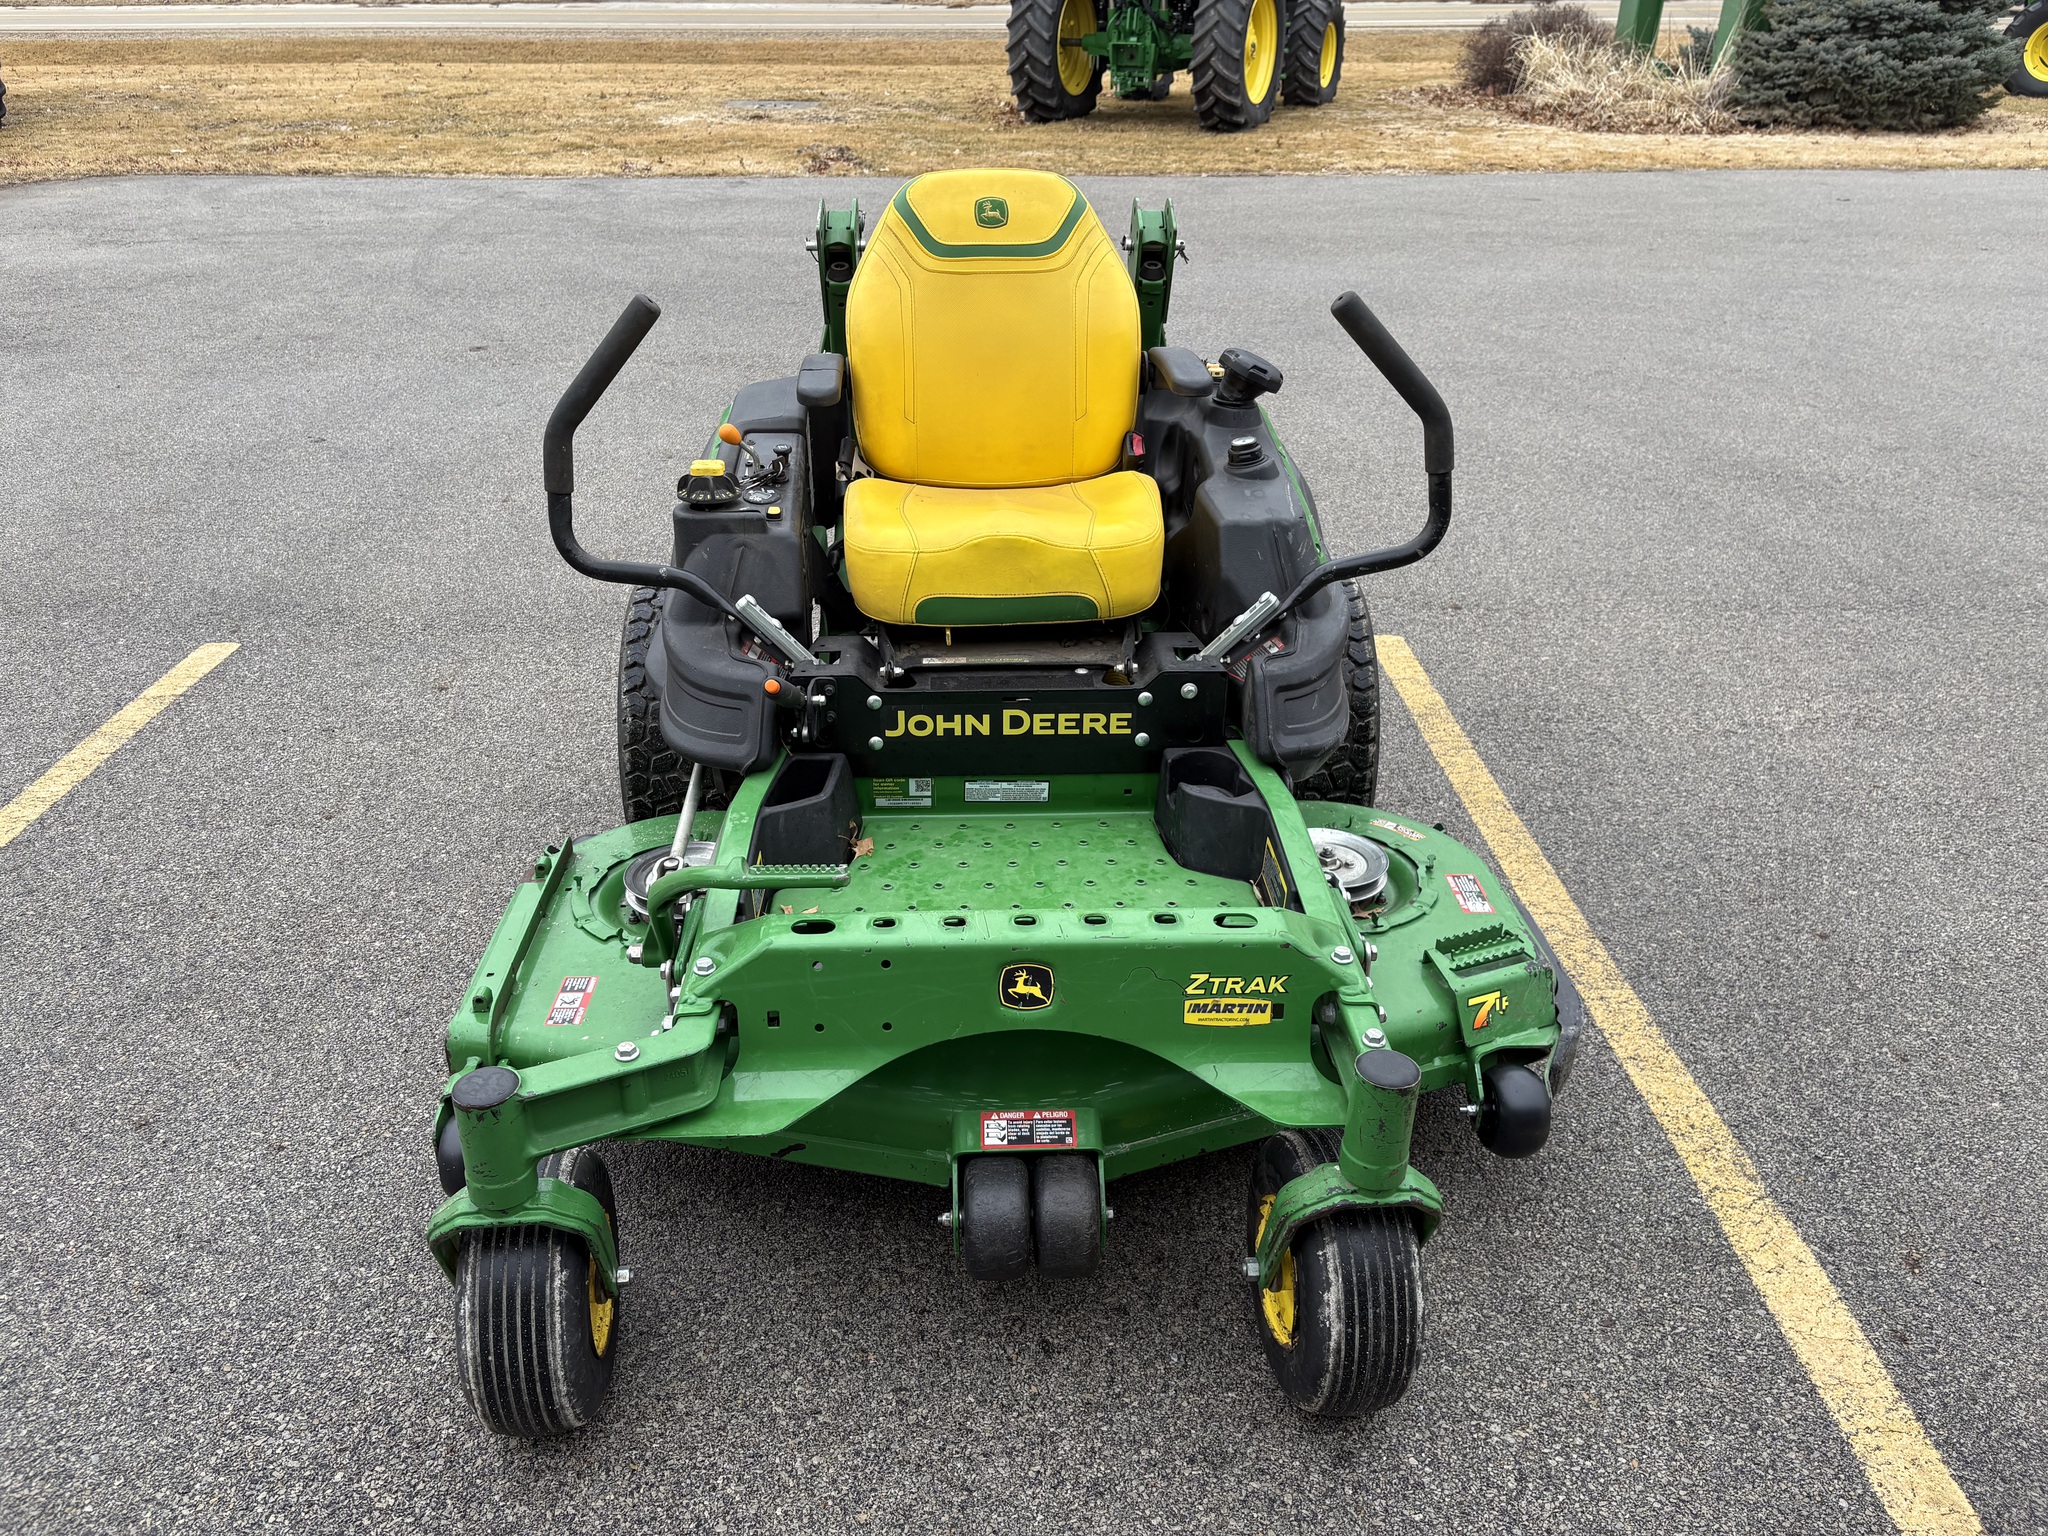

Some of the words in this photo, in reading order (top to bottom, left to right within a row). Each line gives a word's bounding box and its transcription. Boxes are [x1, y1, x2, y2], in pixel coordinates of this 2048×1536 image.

[884, 710, 991, 737] JOHN
[1002, 709, 1133, 736] DEERE
[1184, 973, 1290, 995] ZTRAK
[1187, 1003, 1269, 1014] MARTIN
